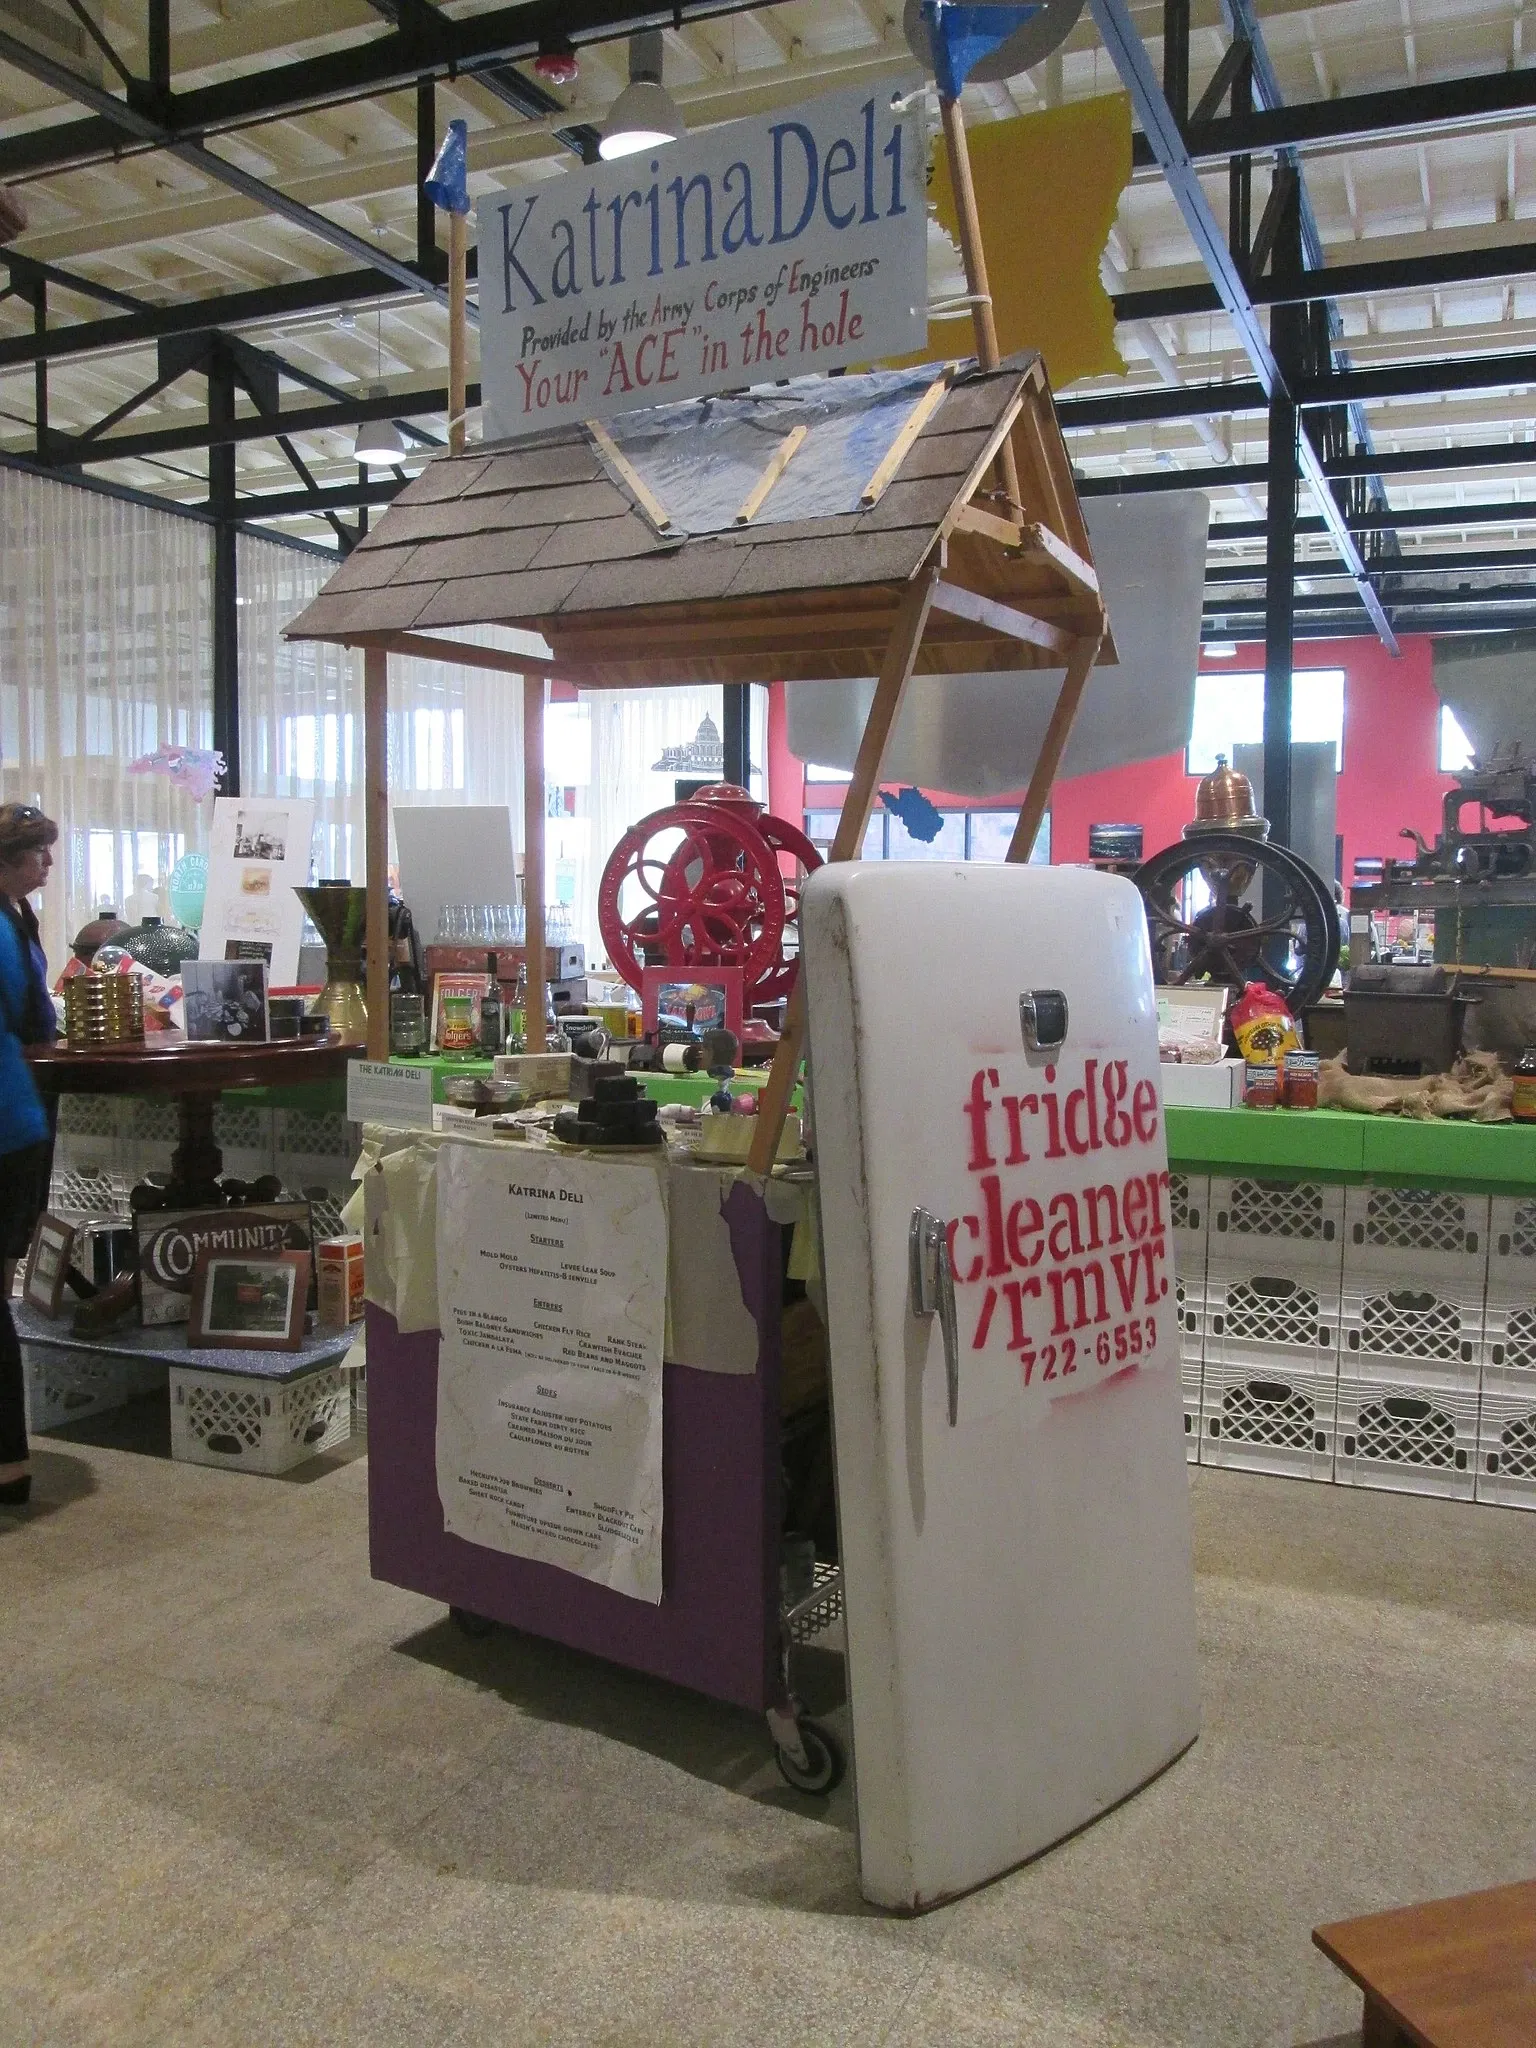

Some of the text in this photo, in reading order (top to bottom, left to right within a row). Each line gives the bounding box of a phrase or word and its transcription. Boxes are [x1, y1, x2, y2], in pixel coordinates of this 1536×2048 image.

[515, 360, 589, 414] Your
[699, 333, 729, 376] in
[740, 308, 790, 366] the
[800, 290, 865, 353] hole
[520, 258, 880, 358] Provided by the Army Corps of Engineers
[359, 1064, 421, 1080] THE KATRINA DELI
[964, 1059, 1158, 1171] fridge
[947, 1168, 1169, 1283] cleaner
[1022, 1316, 1158, 1387] 722-6553
